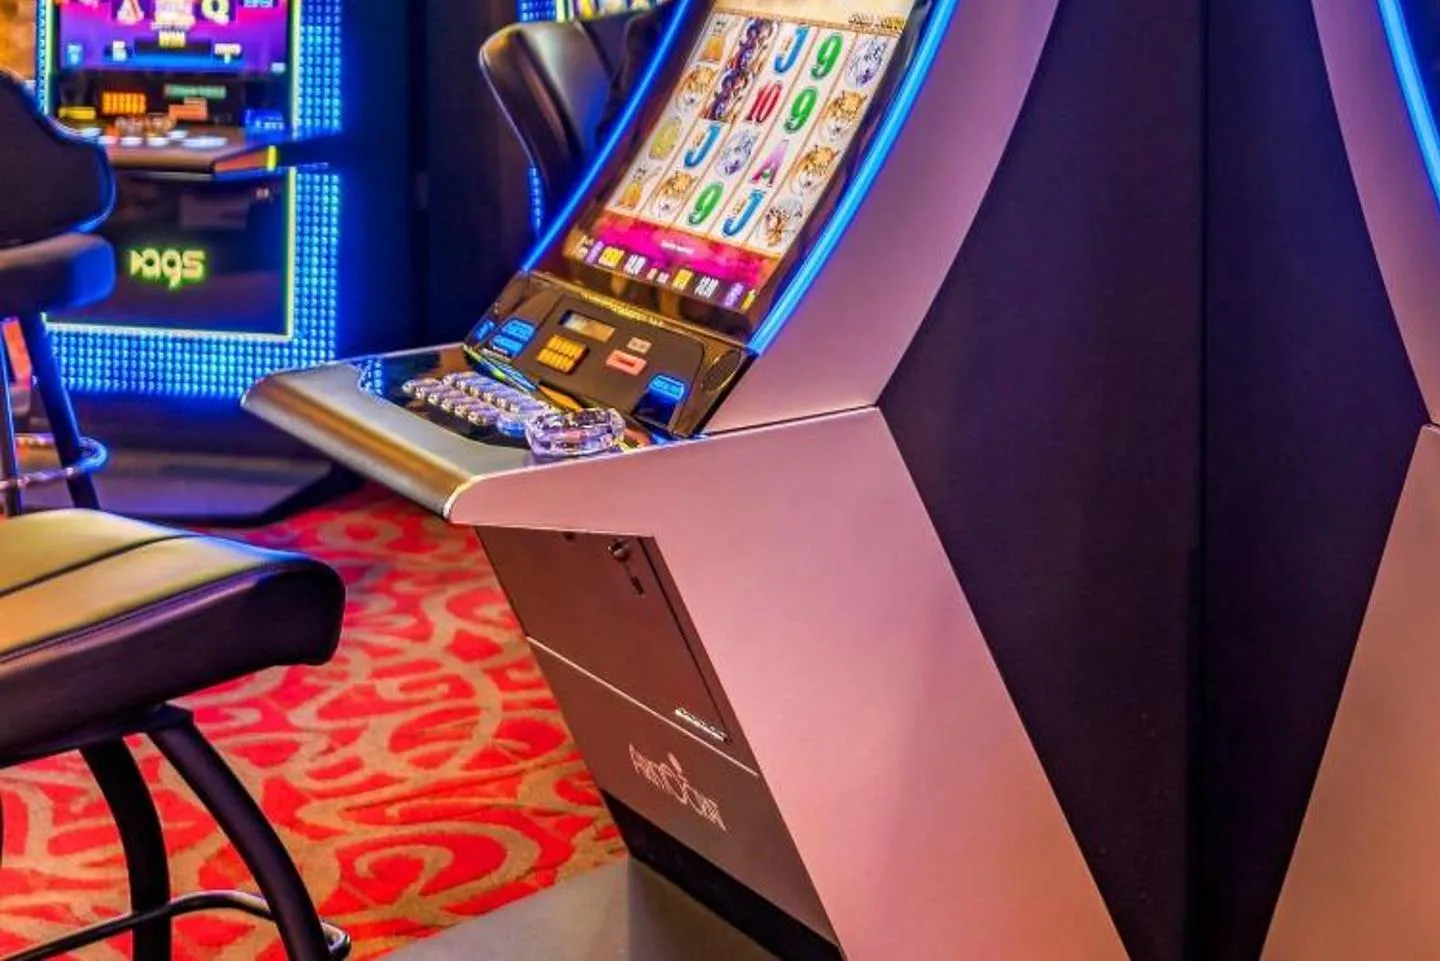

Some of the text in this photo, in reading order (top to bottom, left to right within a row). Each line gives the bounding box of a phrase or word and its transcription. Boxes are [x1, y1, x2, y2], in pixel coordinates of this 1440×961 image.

[774, 25, 811, 74] J
[810, 32, 844, 81] 9
[746, 82, 783, 124] 10
[784, 86, 820, 134] 9
[684, 123, 721, 169] J
[751, 139, 789, 187] A
[688, 181, 725, 226] 9
[721, 189, 767, 238] J
